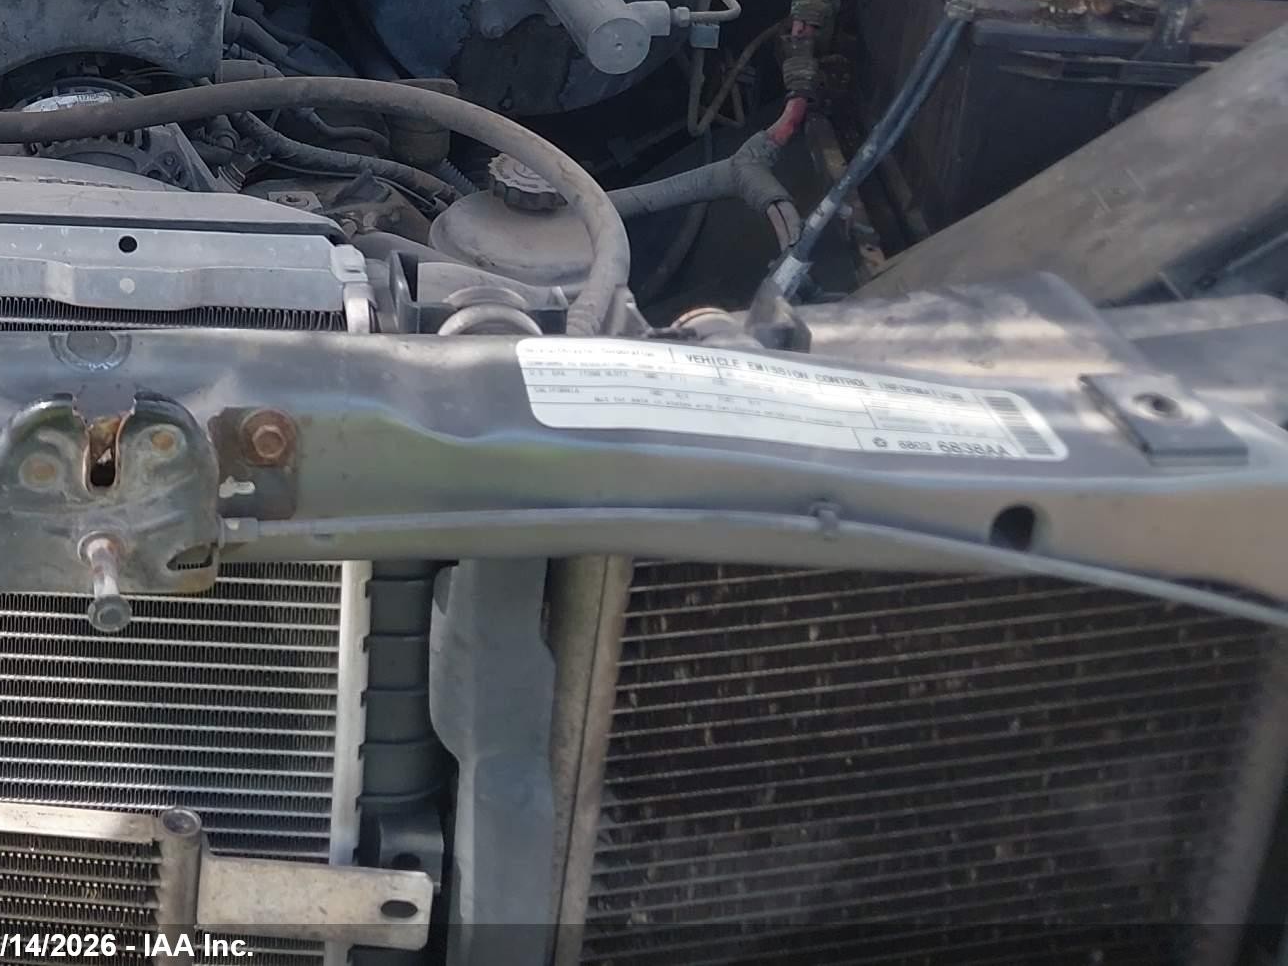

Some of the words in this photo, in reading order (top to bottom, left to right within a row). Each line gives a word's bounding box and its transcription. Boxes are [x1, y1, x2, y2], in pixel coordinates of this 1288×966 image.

[685, 353, 739, 368] VEHICLE
[746, 361, 809, 380] EMISSION
[814, 373, 872, 389] CONTROL
